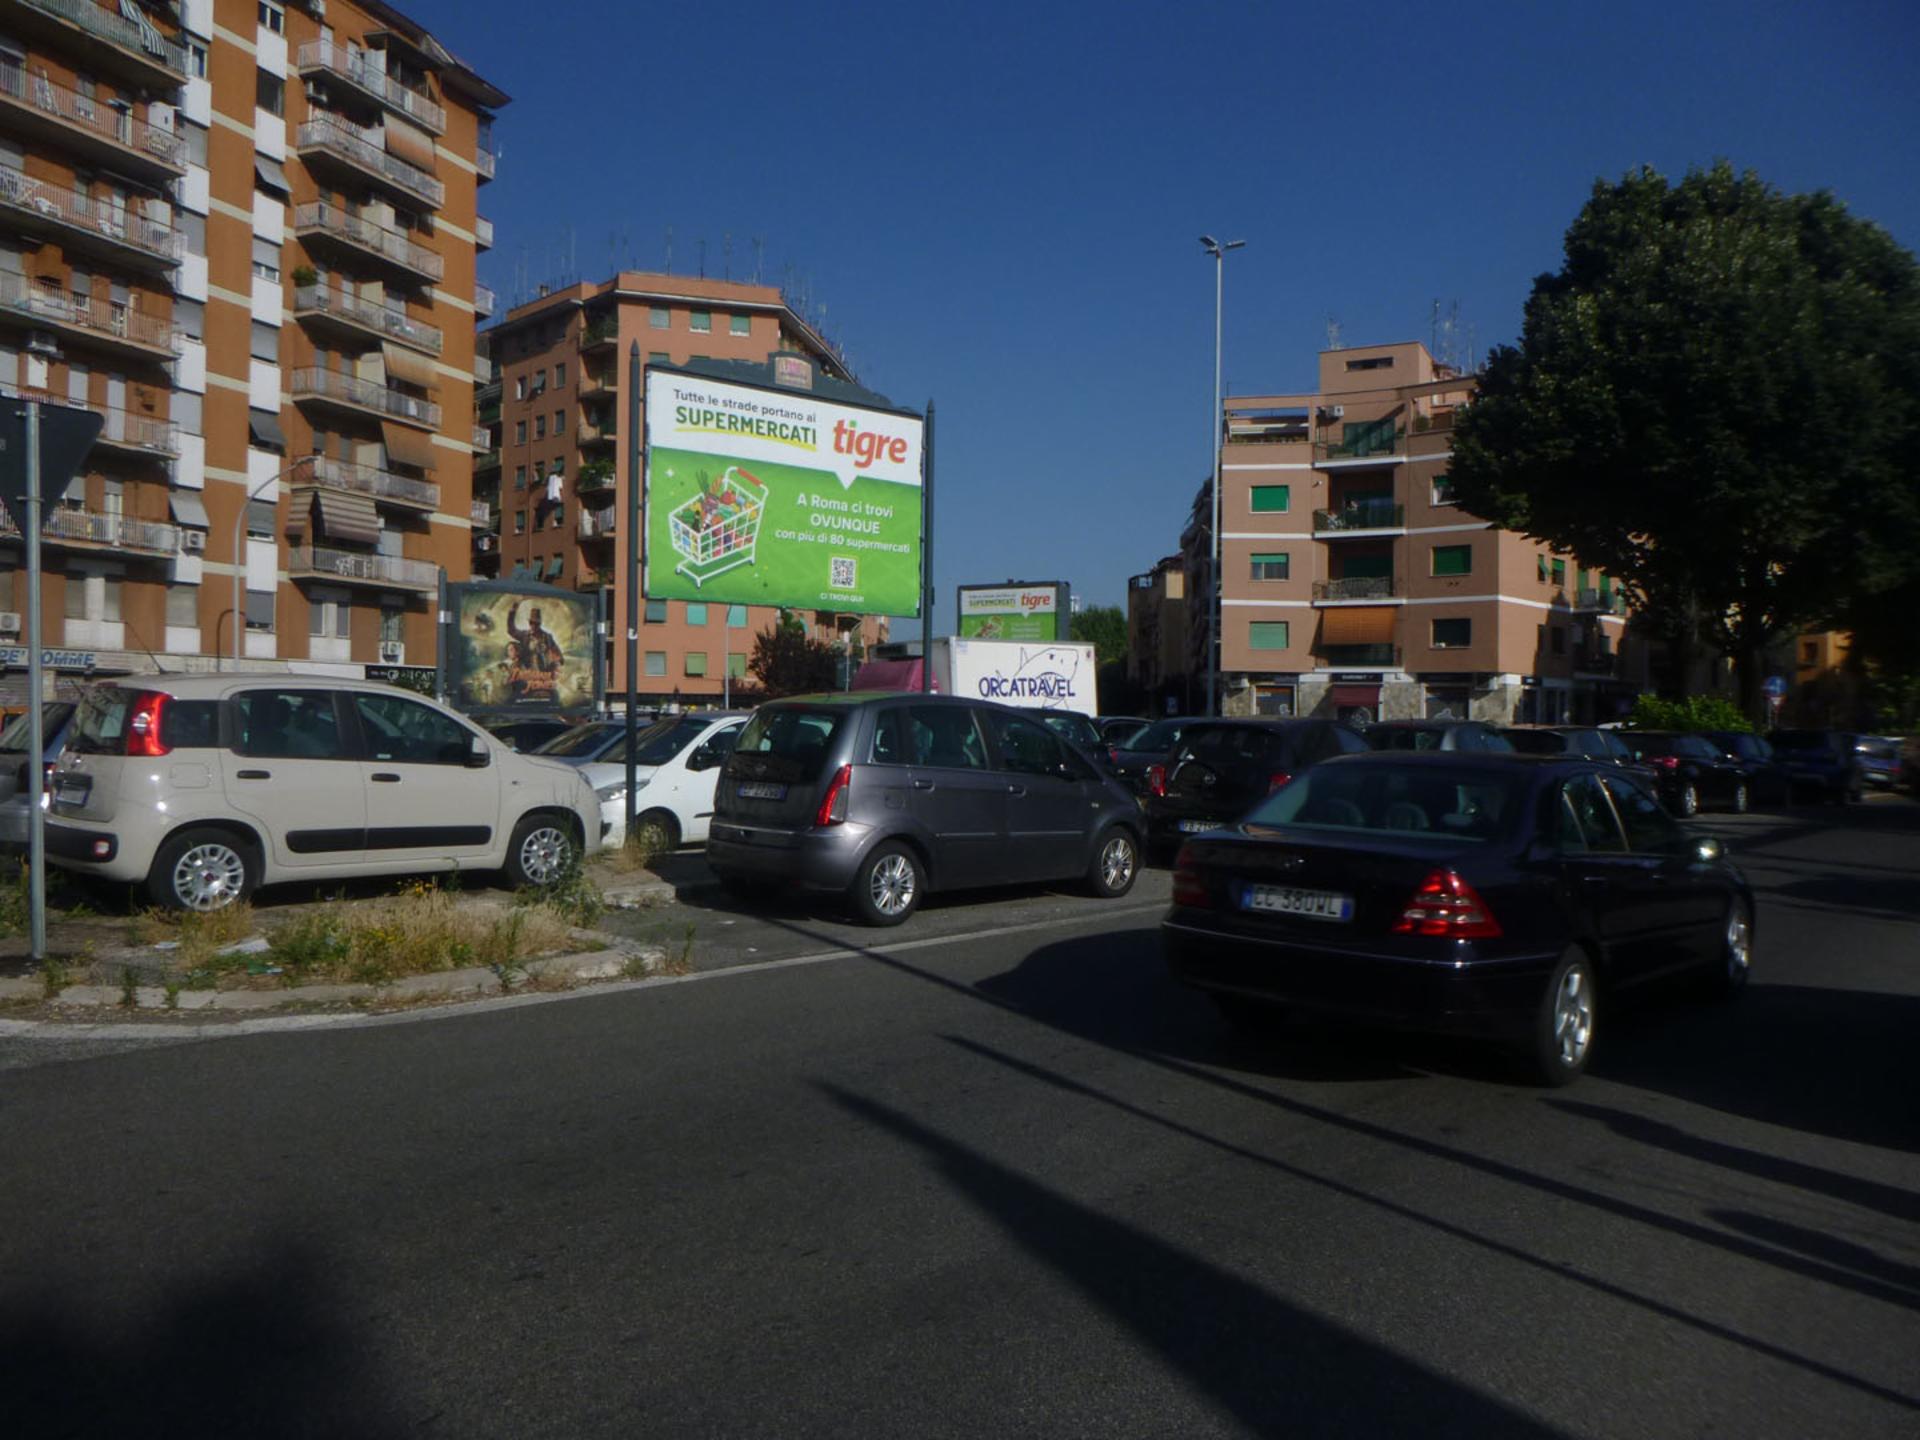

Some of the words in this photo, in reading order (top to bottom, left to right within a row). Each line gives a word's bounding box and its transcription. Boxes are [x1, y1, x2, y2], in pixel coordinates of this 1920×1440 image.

[674, 389, 705, 404] Tutte
[708, 394, 719, 406] le
[722, 398, 758, 412] strade
[761, 406, 804, 421] portano
[806, 411, 816, 423] ai
[675, 405, 817, 445] SUPERMERCATI
[832, 418, 908, 469] tigre
[797, 493, 807, 507] A
[811, 494, 848, 512] Roma
[851, 501, 862, 513] ci
[865, 503, 893, 518] trovi
[810, 513, 880, 535] OVUNQUE
[775, 529, 796, 540] con
[818, 534, 828, 544] di
[830, 534, 844, 545] 80
[847, 537, 911, 554] supermercati
[1021, 592, 1051, 610] tigre
[978, 676, 1076, 698] ORCATRAVEL
